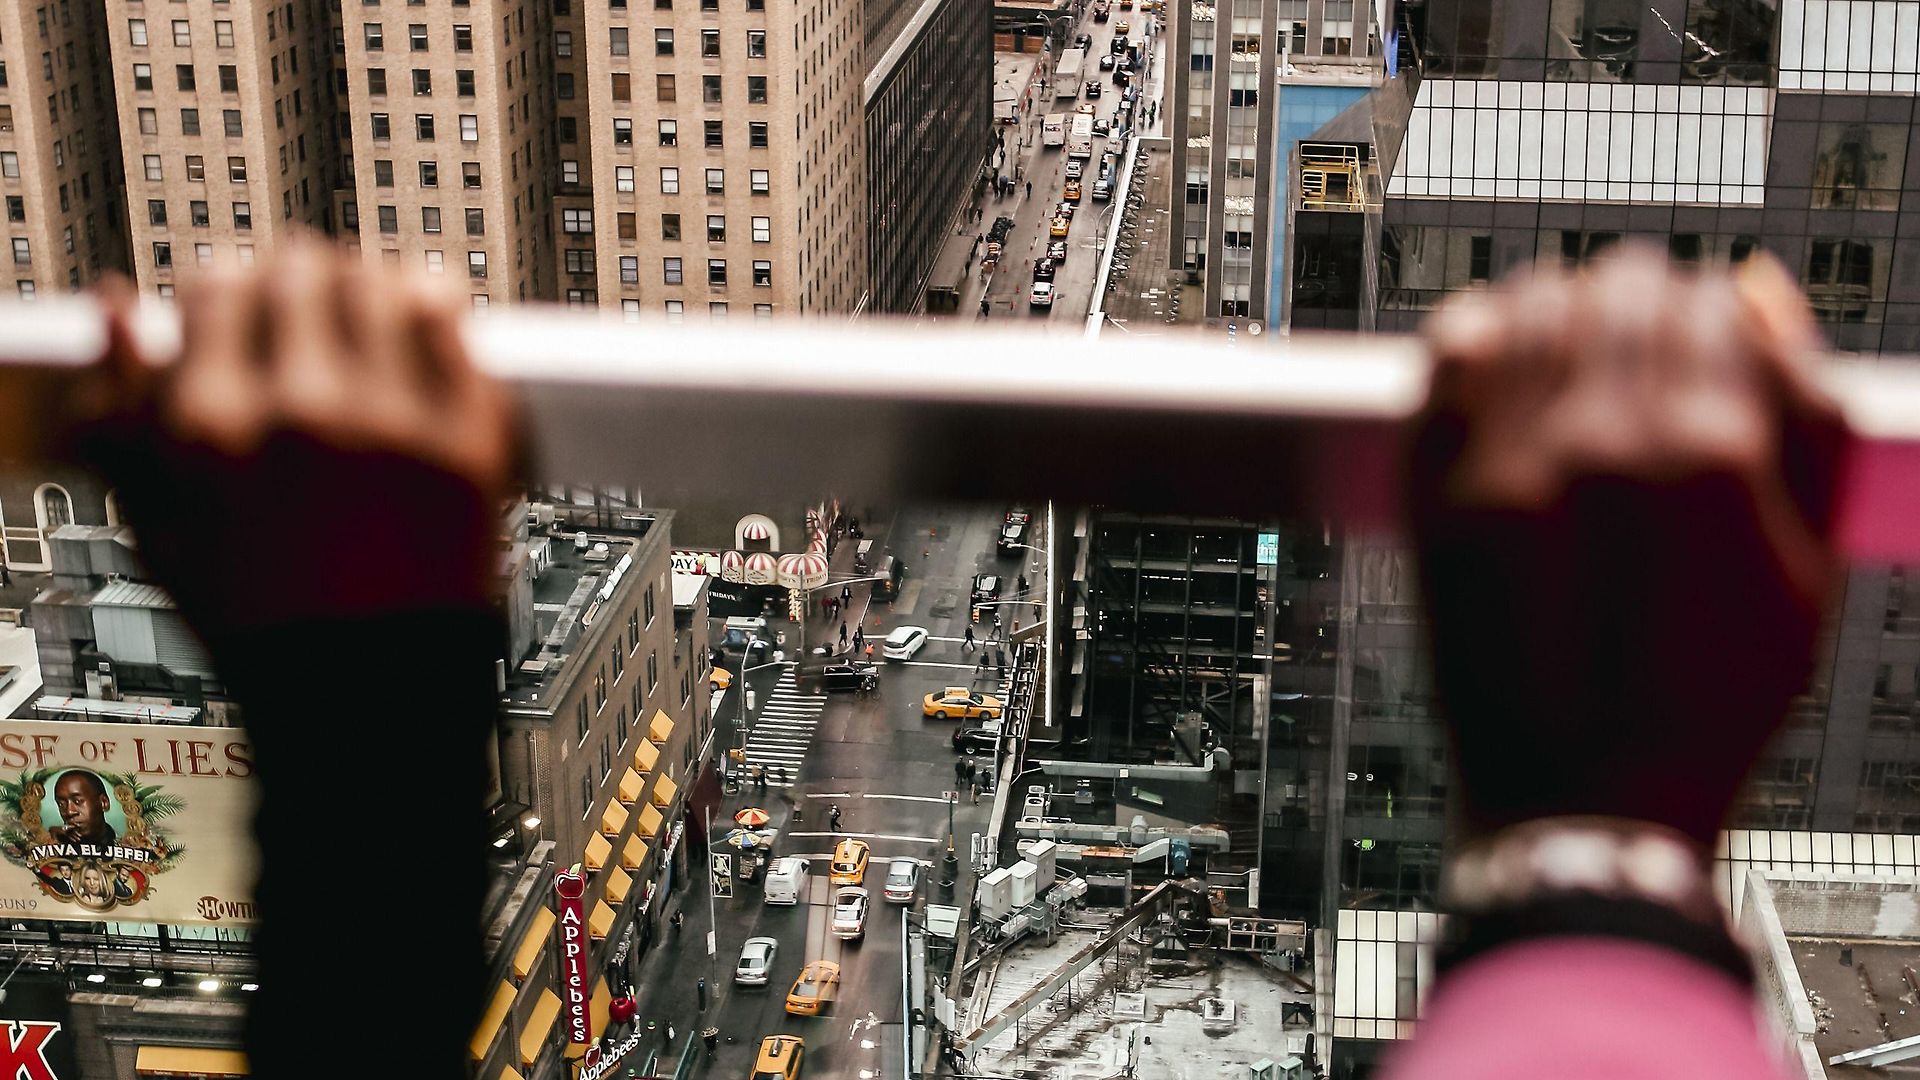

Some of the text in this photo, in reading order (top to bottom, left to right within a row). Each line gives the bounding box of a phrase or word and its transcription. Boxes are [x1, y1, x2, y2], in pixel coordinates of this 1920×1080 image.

[80, 740, 117, 762] OF
[133, 738, 254, 778] LIES
[32, 844, 150, 862] ¡VIVA EL JEFE!
[29, 900, 37, 910] 9
[0, 1020, 61, 1080] K
